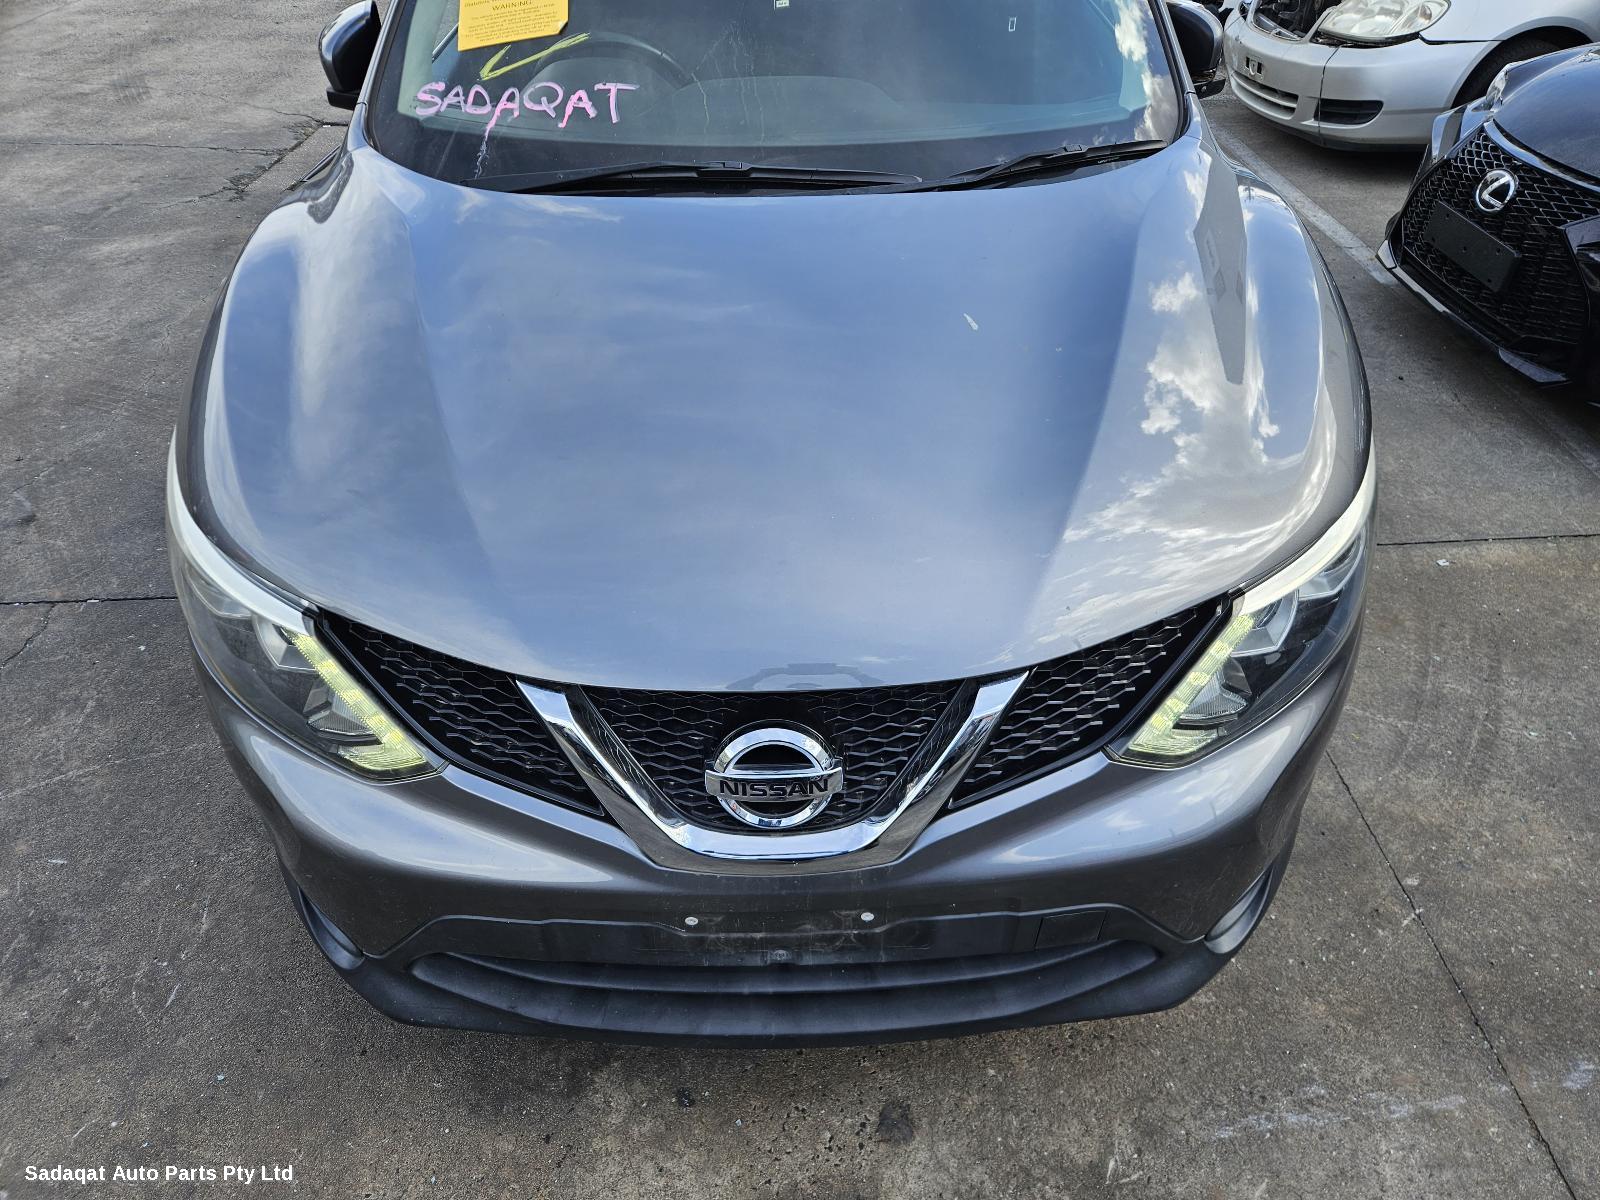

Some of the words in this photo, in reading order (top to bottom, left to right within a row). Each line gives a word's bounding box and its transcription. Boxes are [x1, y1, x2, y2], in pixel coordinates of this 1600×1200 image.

[492, 0, 533, 11] WARNING
[414, 81, 640, 131] SADAQAT
[719, 778, 829, 798] NISSAN
